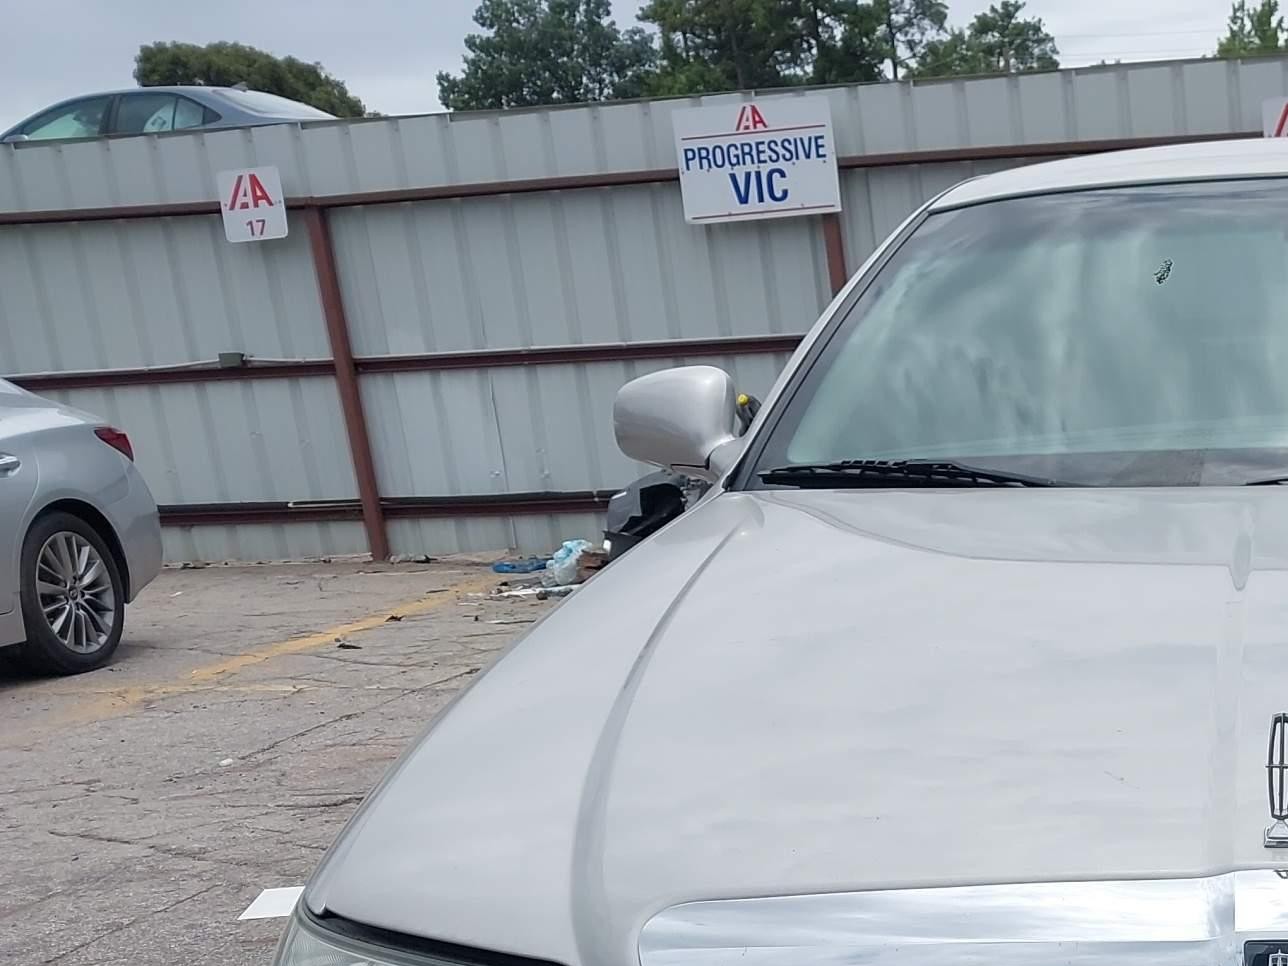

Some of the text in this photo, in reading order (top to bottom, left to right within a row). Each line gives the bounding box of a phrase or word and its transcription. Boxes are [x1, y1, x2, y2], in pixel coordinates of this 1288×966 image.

[683, 135, 827, 171] PROGRESSIVE
[729, 167, 789, 205] VIC
[246, 218, 266, 236] 17
